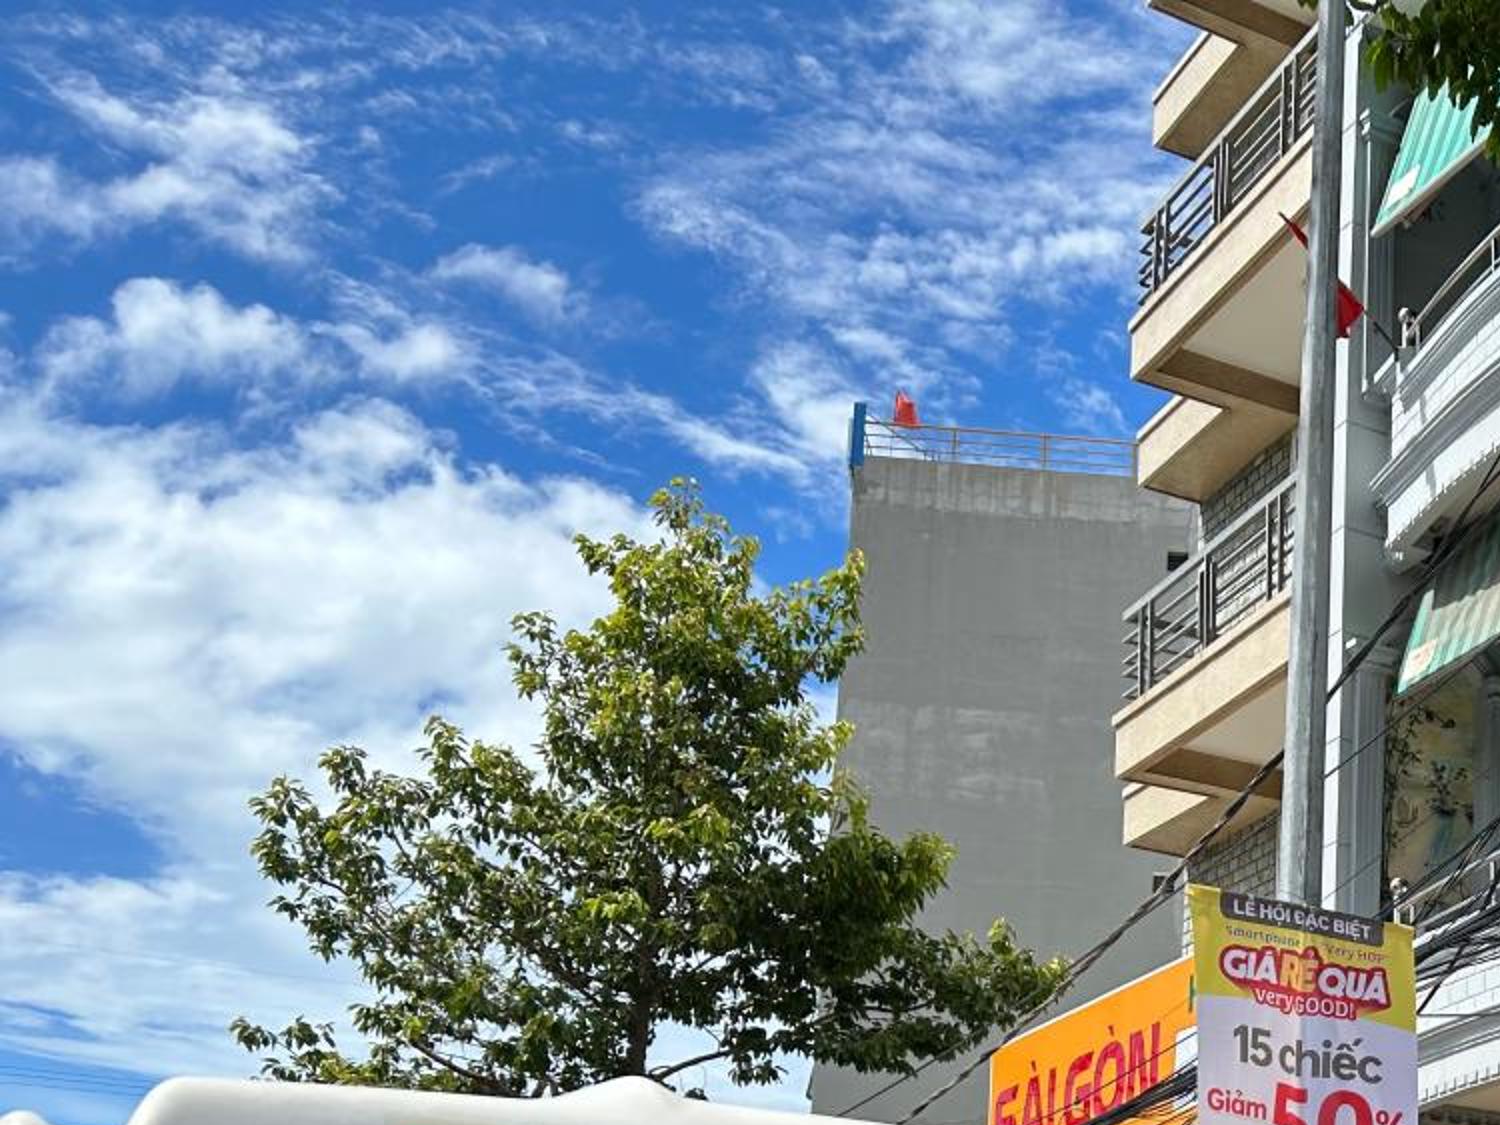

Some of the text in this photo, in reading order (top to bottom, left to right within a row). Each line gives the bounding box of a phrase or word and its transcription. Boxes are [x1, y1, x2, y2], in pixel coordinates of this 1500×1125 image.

[1258, 899, 1292, 928] HỘI
[1293, 903, 1330, 932] ĐẶC
[1333, 916, 1372, 942] BIỆT
[1222, 944, 1389, 1006] GIÁ RẺ QUÁ
[1233, 1025, 1383, 1085] 15 chiếc
[1206, 1086, 1268, 1121] Giảm
